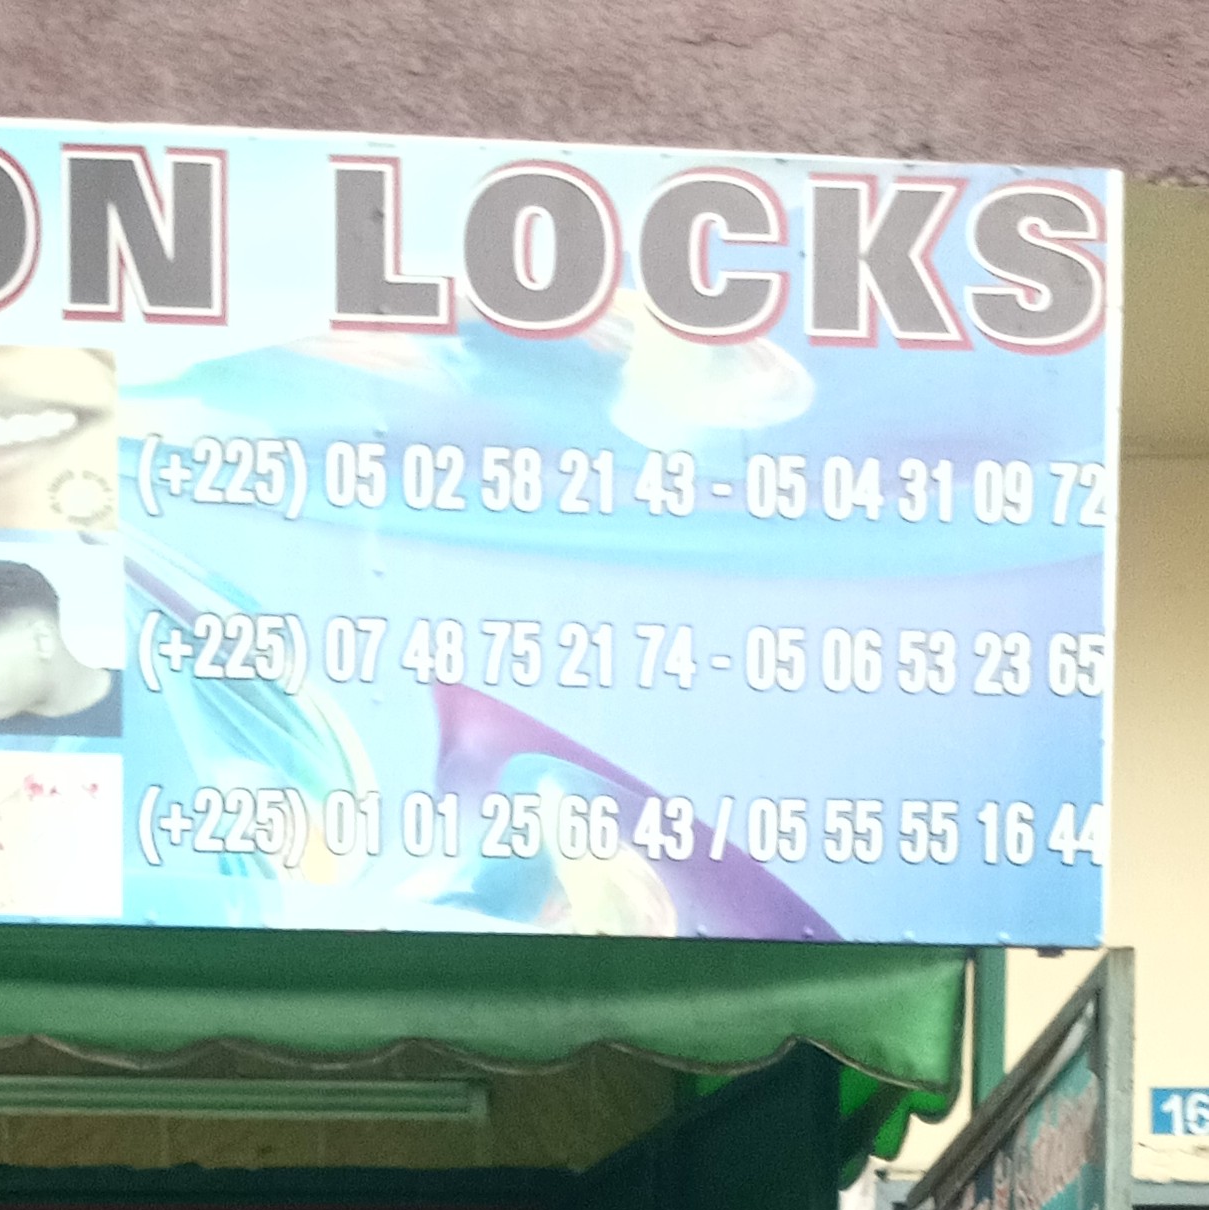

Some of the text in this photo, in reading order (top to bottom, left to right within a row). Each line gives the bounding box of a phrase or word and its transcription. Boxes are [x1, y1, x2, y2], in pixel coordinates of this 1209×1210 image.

[329, 154, 1107, 353] LOCKS
[138, 434, 308, 519] (+225)
[325, 441, 387, 508] 05
[402, 444, 466, 510] 02
[480, 446, 542, 512] 58
[559, 449, 614, 514] 21
[634, 450, 695, 516] 43
[746, 453, 806, 519] 05
[822, 456, 884, 521] 04
[897, 458, 954, 523] 31
[973, 460, 1032, 524] 09
[1050, 461, 1106, 526] 72
[138, 611, 308, 695] (+225)
[325, 616, 387, 682] 07
[401, 618, 465, 684] 48
[480, 620, 542, 686] 75
[558, 621, 614, 688] 21
[635, 624, 696, 689] 74
[745, 626, 806, 691] 05
[822, 627, 882, 692] 06
[897, 630, 956, 695] 53
[973, 631, 1032, 696] 23
[1048, 632, 1105, 696] 65
[138, 784, 309, 868] (+225)
[324, 790, 381, 856] 01
[403, 791, 460, 857] 01
[481, 793, 542, 859] 25
[558, 795, 620, 860] 66
[633, 796, 695, 861] 43
[748, 798, 808, 862] 05
[824, 799, 884, 863] 55
[900, 800, 959, 864] 55
[977, 801, 1035, 865] 16
[1048, 802, 1104, 866] 44
